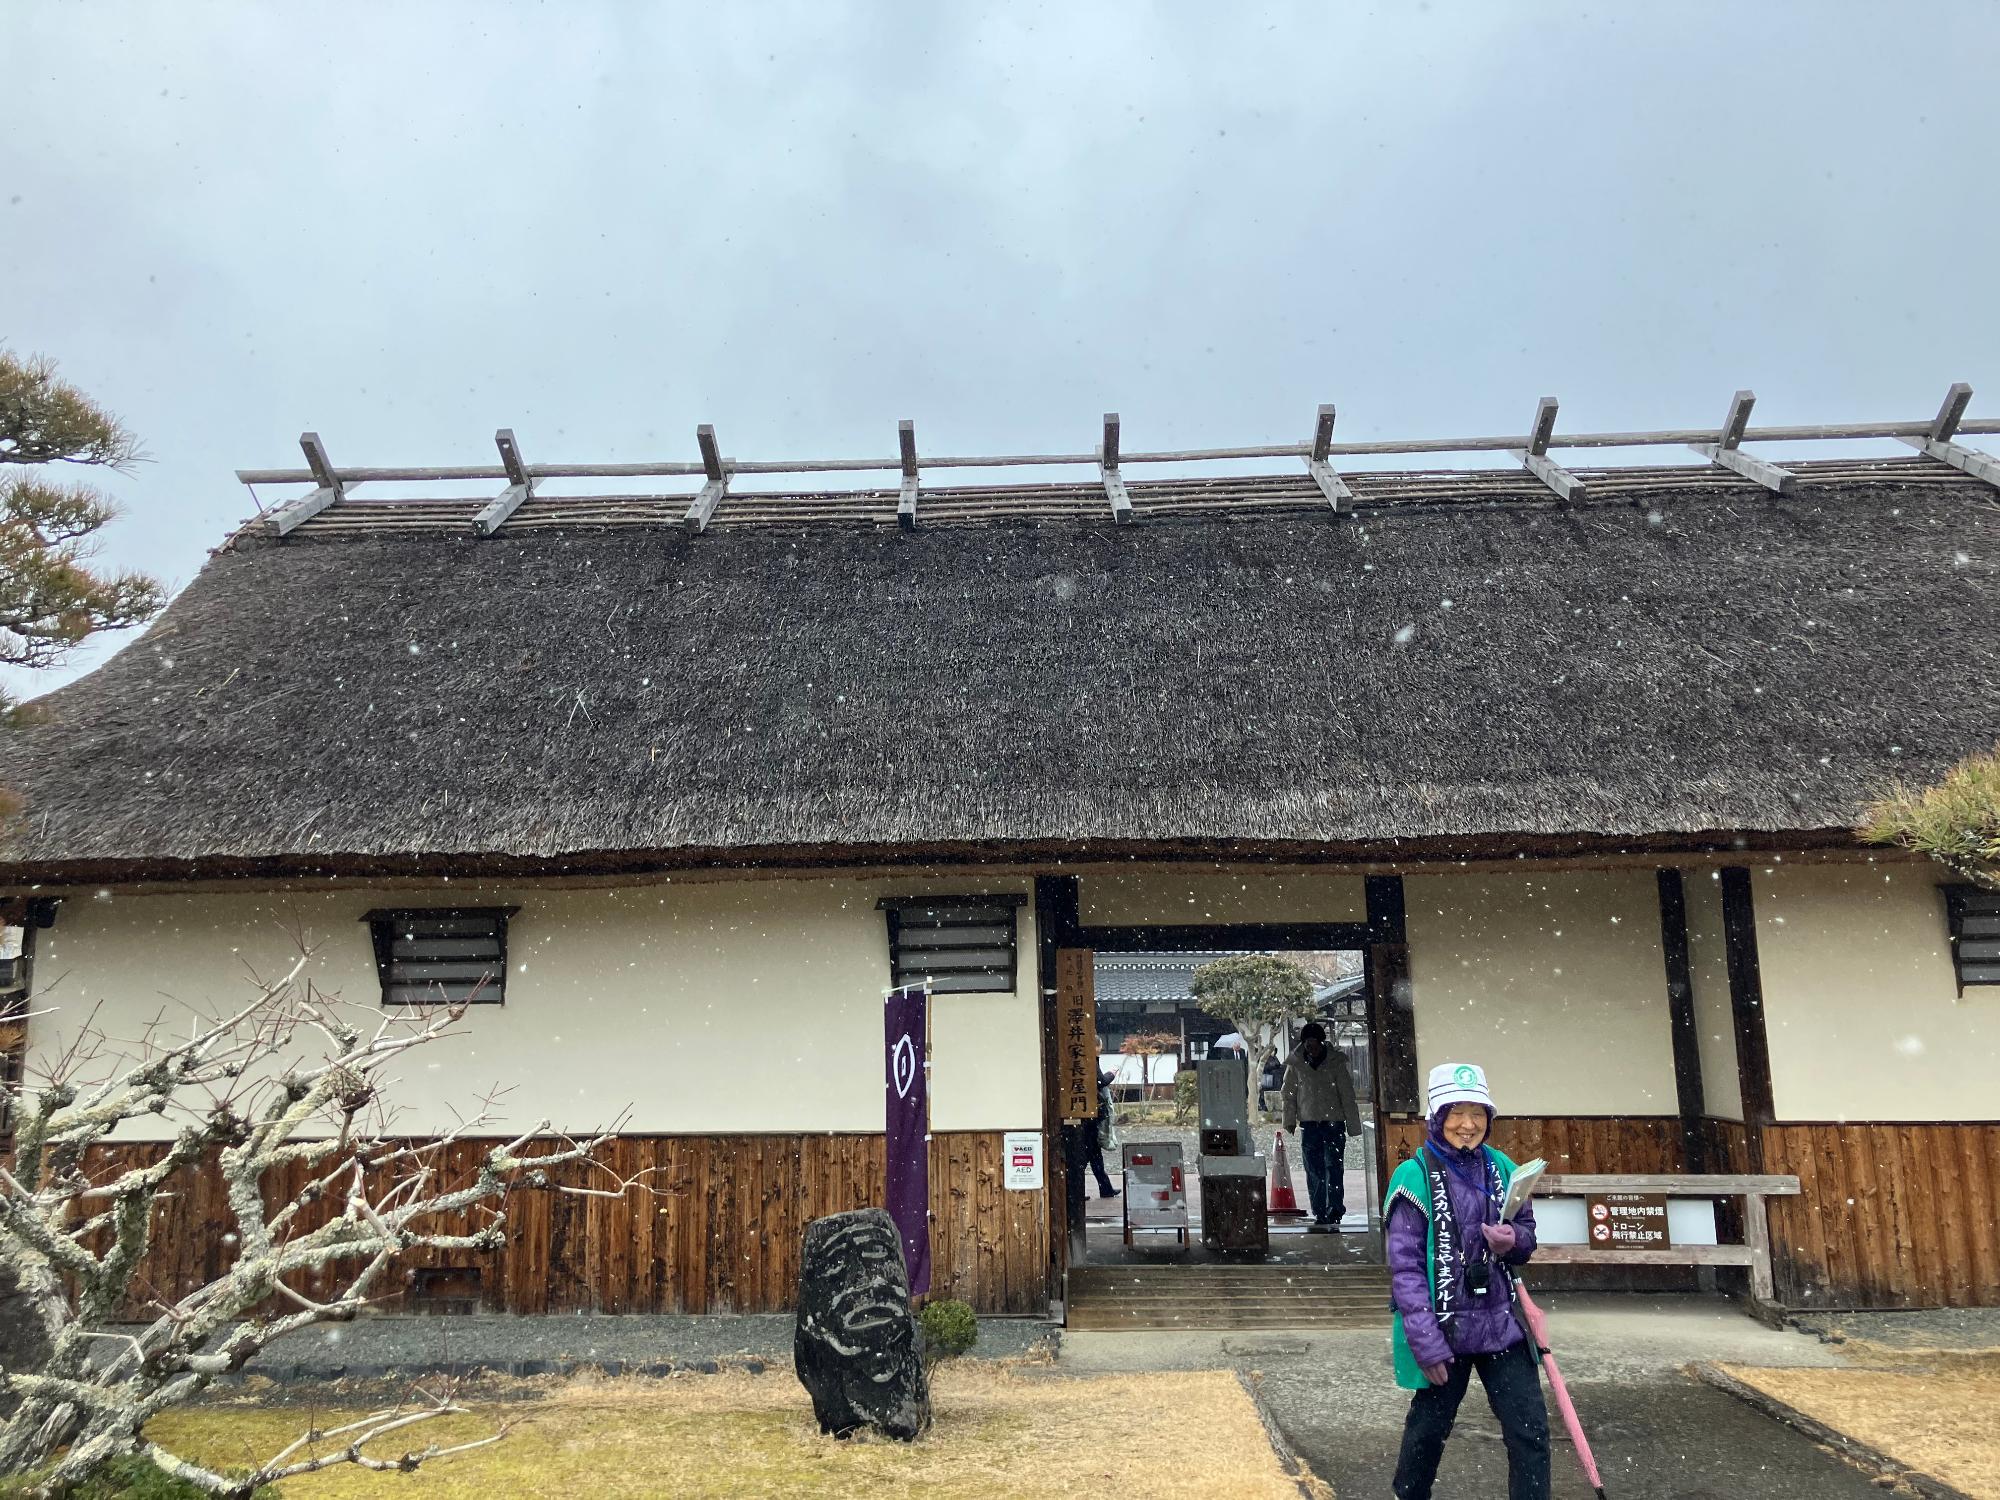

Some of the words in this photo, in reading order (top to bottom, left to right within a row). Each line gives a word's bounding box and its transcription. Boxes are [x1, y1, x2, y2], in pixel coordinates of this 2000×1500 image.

[1067, 995, 1087, 1112] 旧澤井家長屋門
[1015, 1166, 1032, 1174] AED
[1610, 1206, 1664, 1216] 管理地内禁煙
[1613, 1222, 1645, 1231] ドローン
[1612, 1230, 1663, 1241] 飛行禁止区域
[1430, 1170, 1455, 1323] ディスカバーささやまグループ
